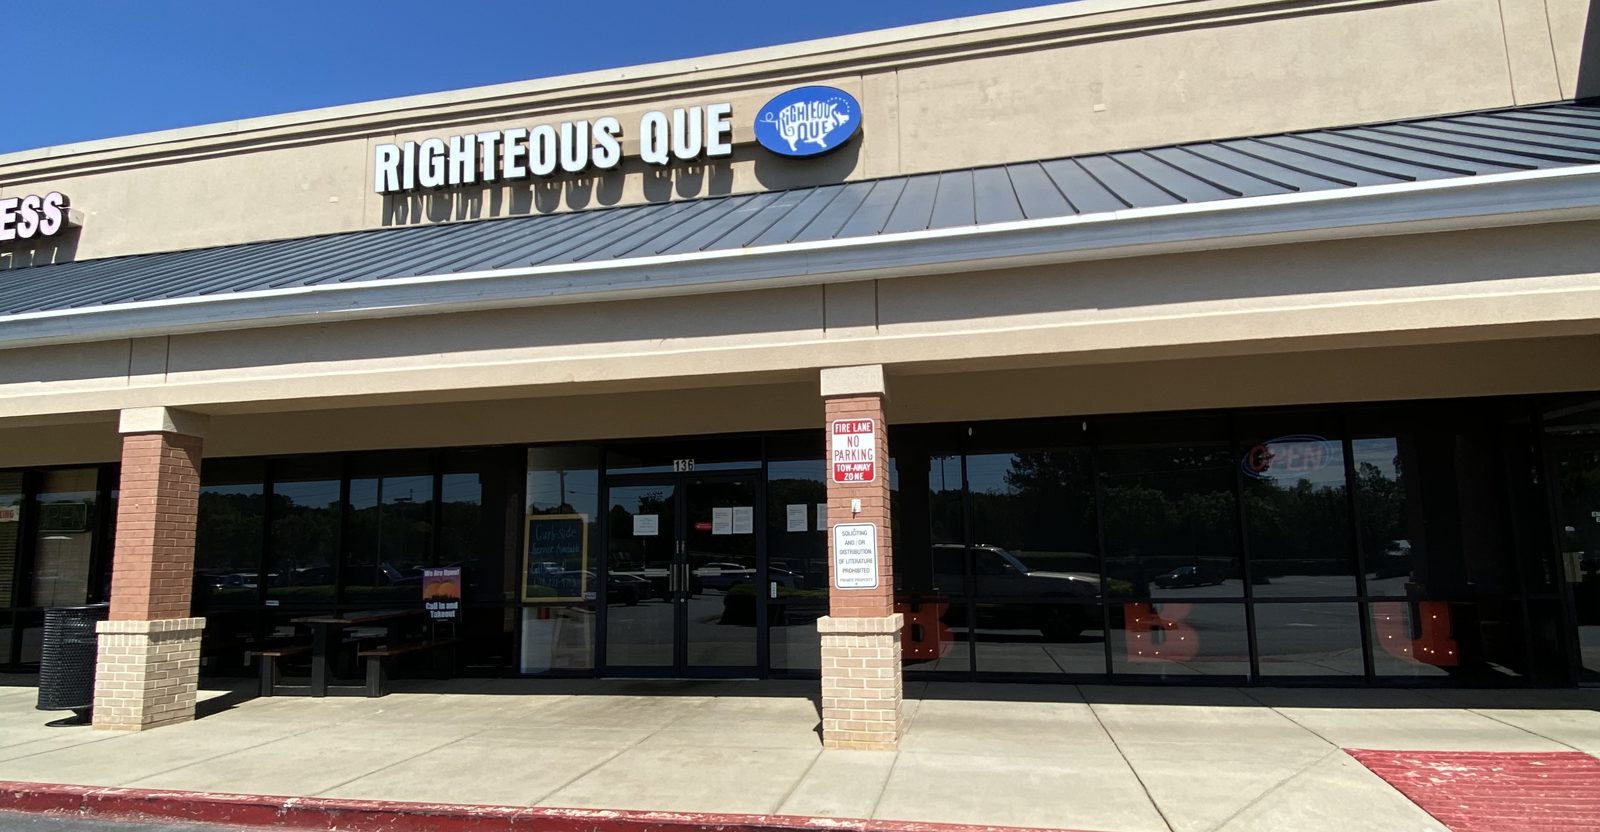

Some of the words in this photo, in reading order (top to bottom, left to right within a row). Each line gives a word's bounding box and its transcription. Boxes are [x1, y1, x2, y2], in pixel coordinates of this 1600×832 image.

[797, 120, 829, 140] QUE
[374, 117, 621, 194] RIGHTEOUS
[640, 103, 732, 166] QUE
[0, 191, 64, 241] ESS
[835, 423, 850, 433] FIRE
[852, 422, 871, 432] LANE
[847, 435, 859, 448] NO
[834, 448, 873, 461] PARKING
[1248, 442, 1322, 471] OPEN
[675, 457, 693, 471] 136
[836, 463, 871, 472] TOW-AWAY
[844, 472, 864, 481] ZONE
[425, 602, 438, 610] Call
[446, 601, 459, 609] and
[430, 610, 456, 619] Takeout
